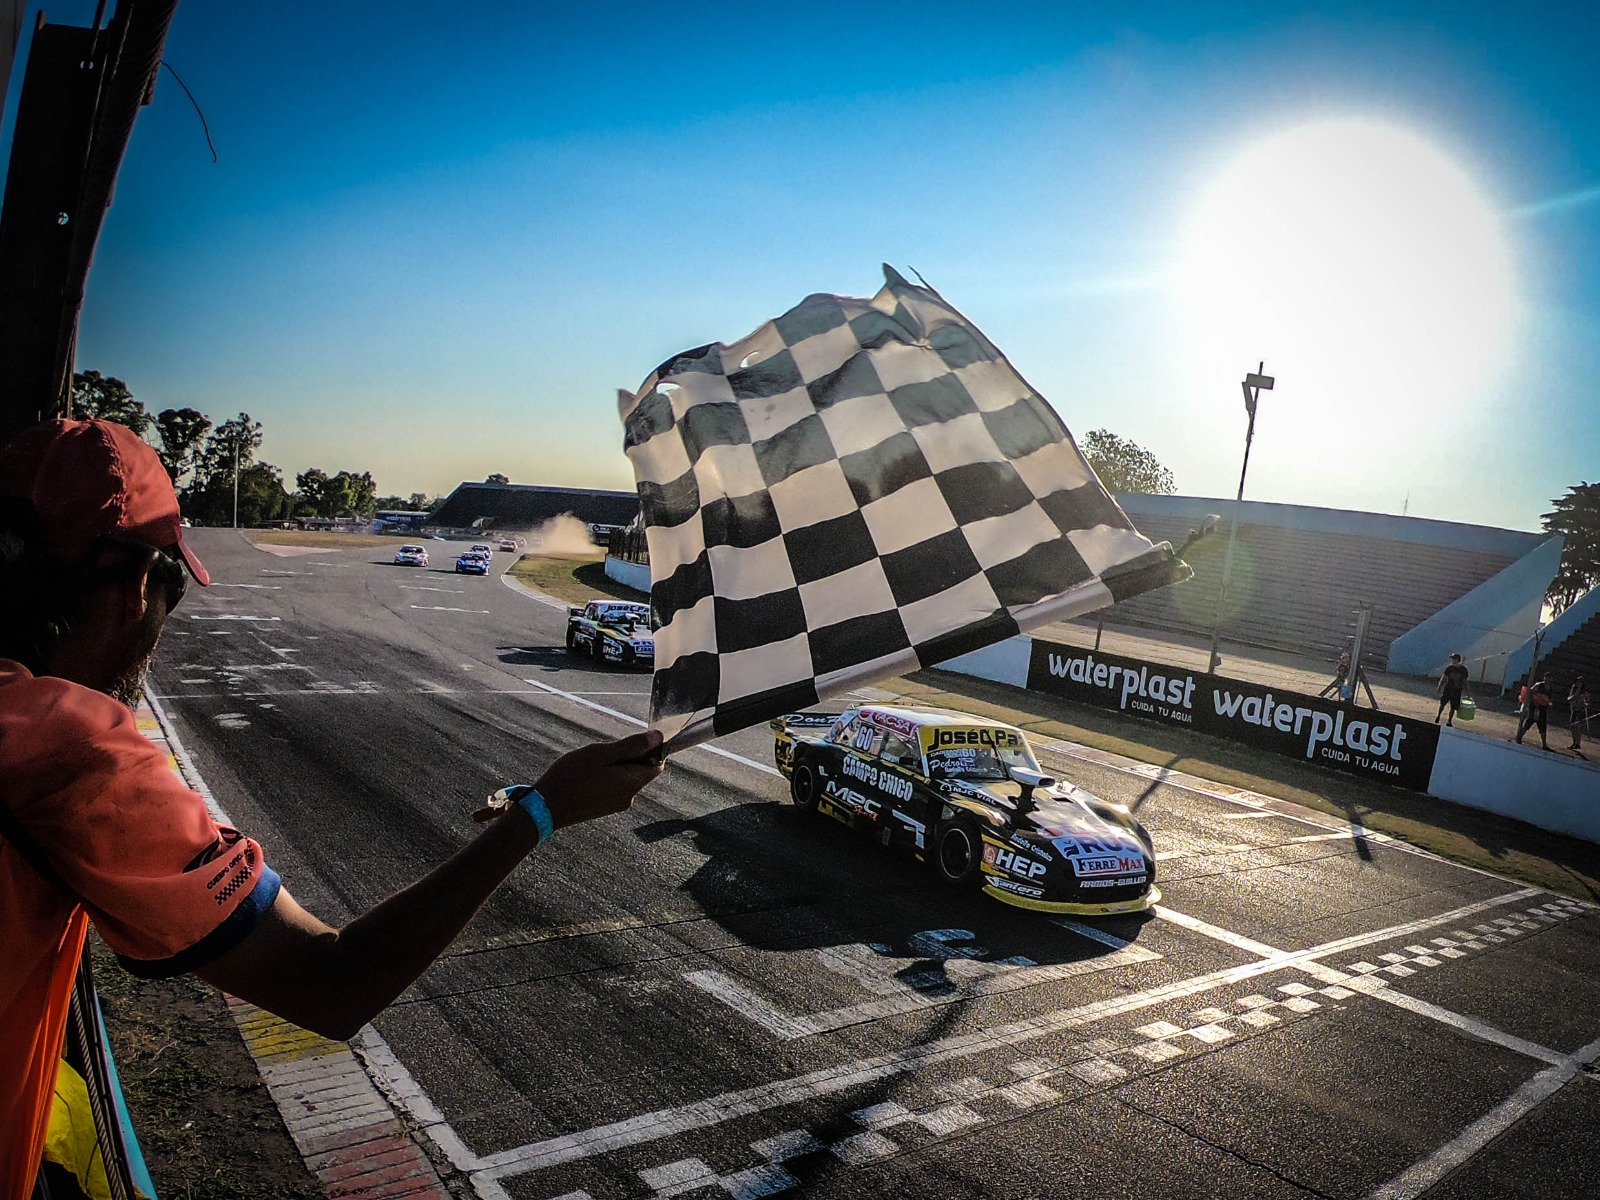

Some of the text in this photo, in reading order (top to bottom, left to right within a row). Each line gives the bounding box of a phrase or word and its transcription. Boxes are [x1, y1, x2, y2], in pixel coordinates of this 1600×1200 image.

[1049, 653, 1196, 710] waterplast
[1132, 700, 1192, 723] CUIDA TU AGUA
[1213, 689, 1407, 761] waterplast
[856, 726, 874, 751] 60
[1321, 747, 1400, 776] CUIDA TU AGUA
[842, 756, 914, 802] CAMPO CHICO
[995, 848, 1047, 878] HEP
